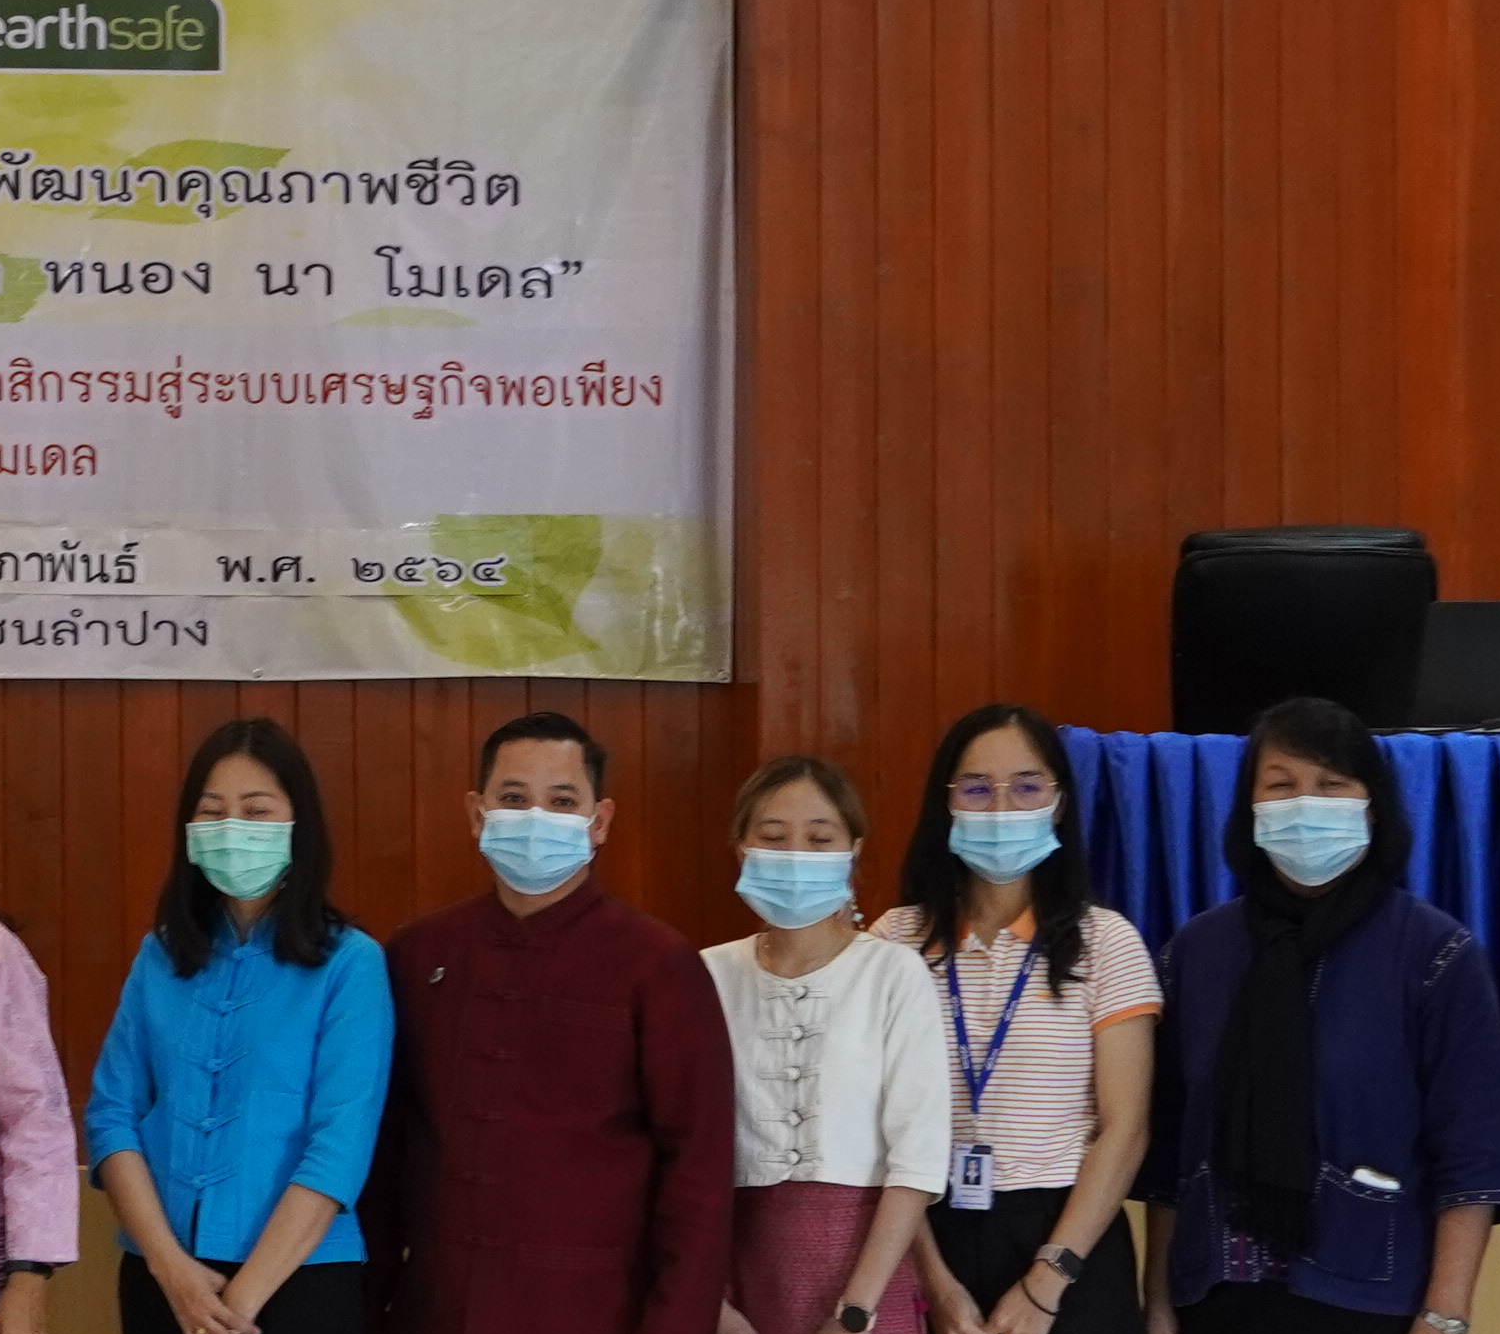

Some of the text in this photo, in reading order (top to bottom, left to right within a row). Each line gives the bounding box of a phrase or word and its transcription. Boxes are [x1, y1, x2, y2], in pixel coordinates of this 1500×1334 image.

[44, 256, 212, 298] หนอง
[254, 259, 335, 299] นา
[373, 244, 585, 301] โมเดล”
[217, 551, 317, 585] พ.ศ.
[350, 550, 507, 586] ๒๕๖๔
